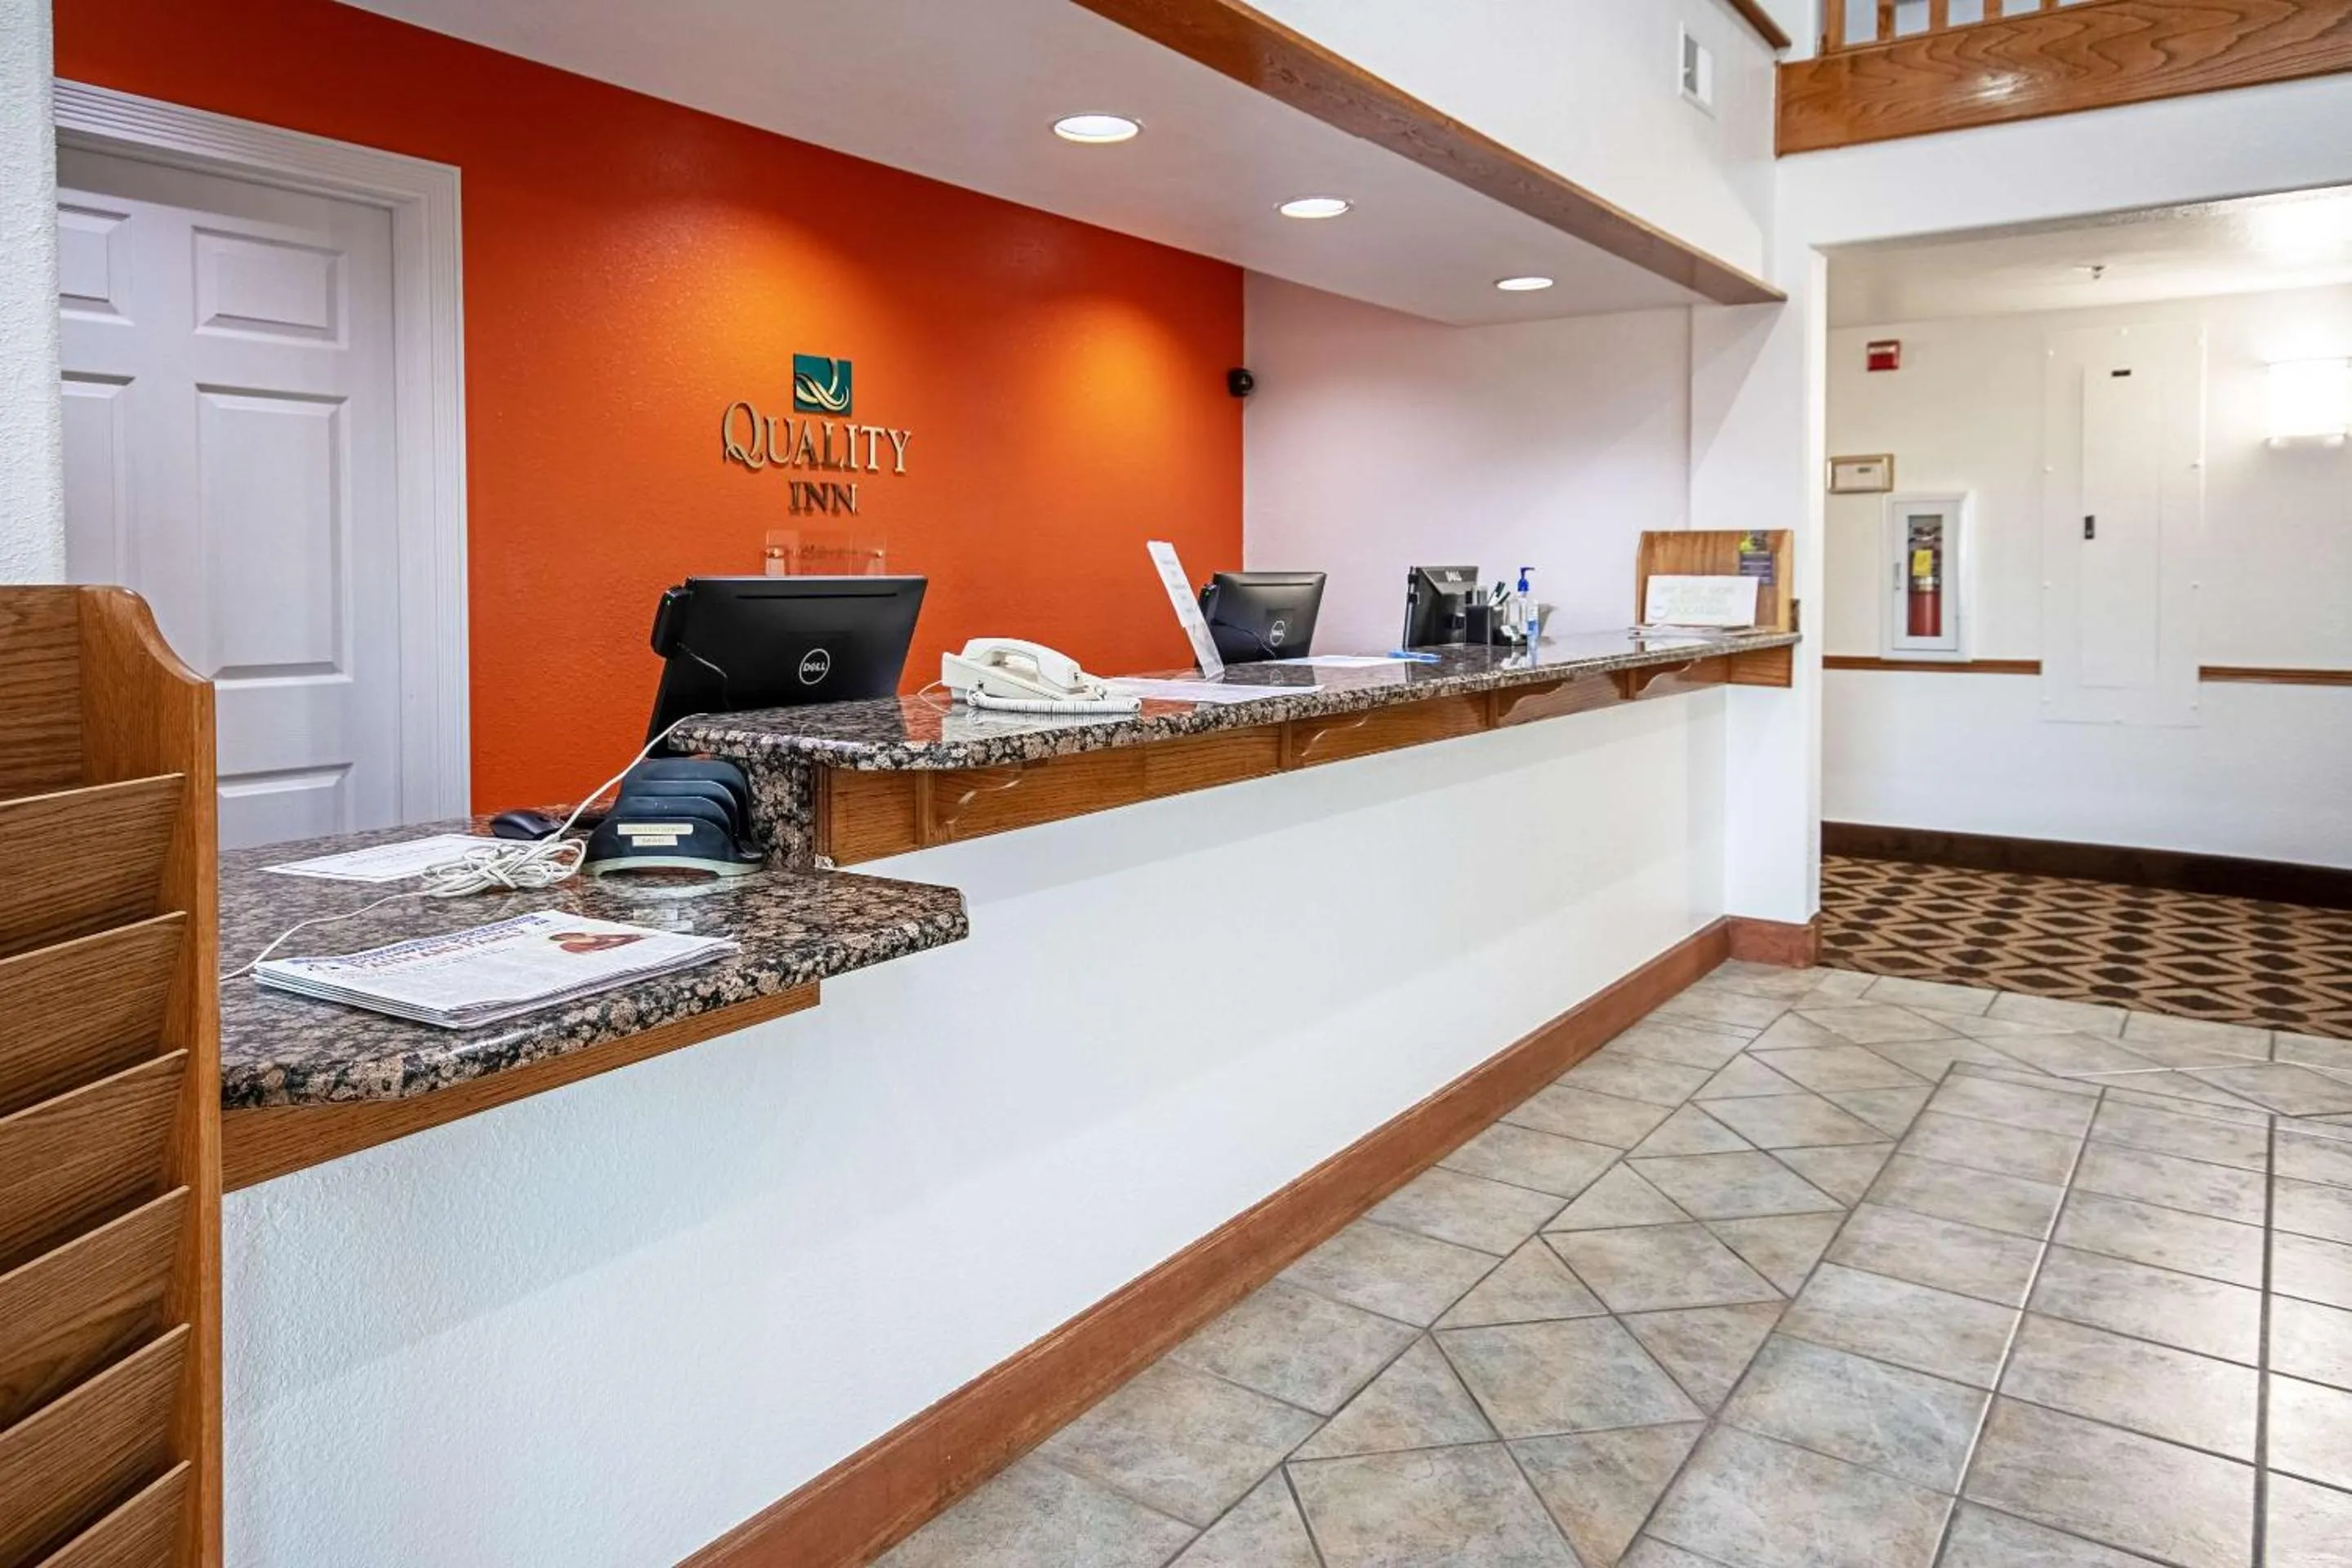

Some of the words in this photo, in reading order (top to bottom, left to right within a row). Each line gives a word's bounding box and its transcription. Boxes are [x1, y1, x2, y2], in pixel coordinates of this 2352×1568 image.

[723, 401, 911, 473] QUALITY
[789, 480, 858, 516] INN
[803, 662, 826, 672] DELL
